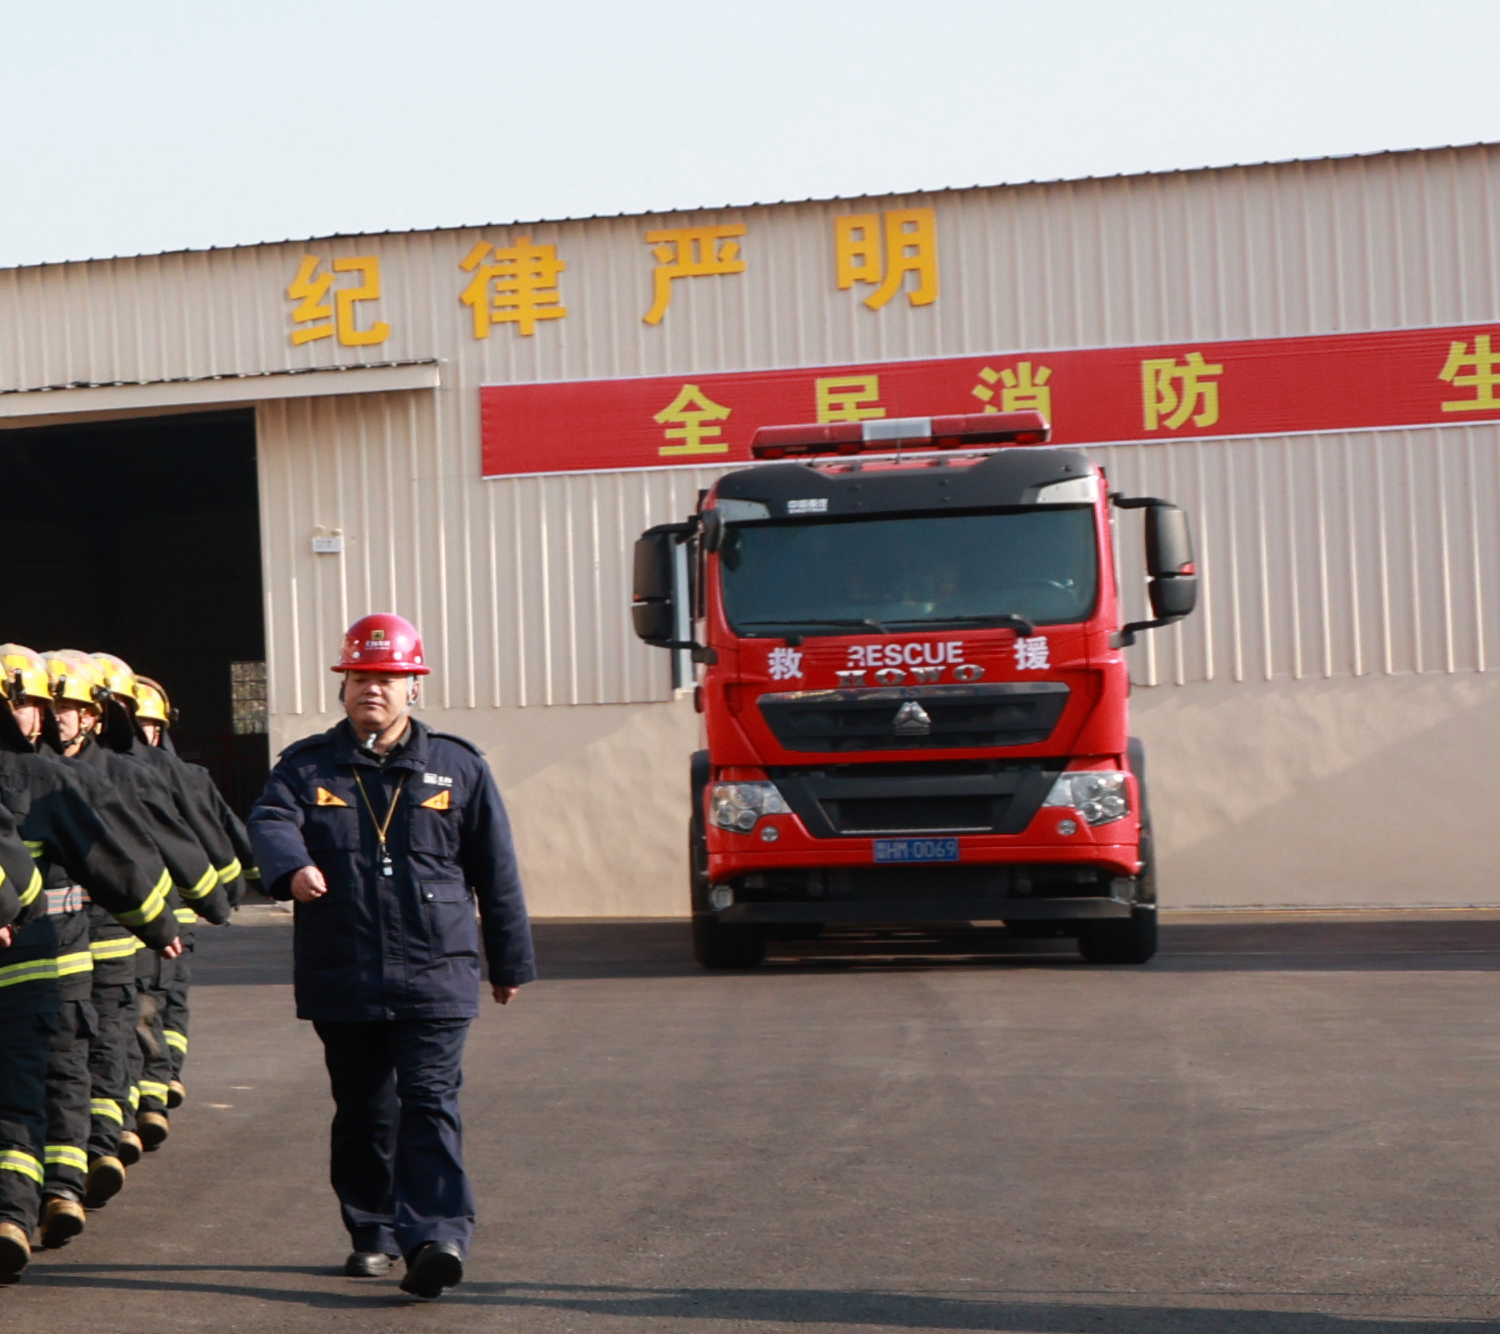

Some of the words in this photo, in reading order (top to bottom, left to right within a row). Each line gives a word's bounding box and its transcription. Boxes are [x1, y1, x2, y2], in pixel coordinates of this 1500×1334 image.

[286, 207, 940, 347] 纪律严明
[653, 352, 1225, 458] 全民消防
[1438, 335, 1500, 414] 生
[768, 646, 804, 681] 救
[847, 641, 965, 667] RESCUE
[1013, 635, 1051, 671] 援
